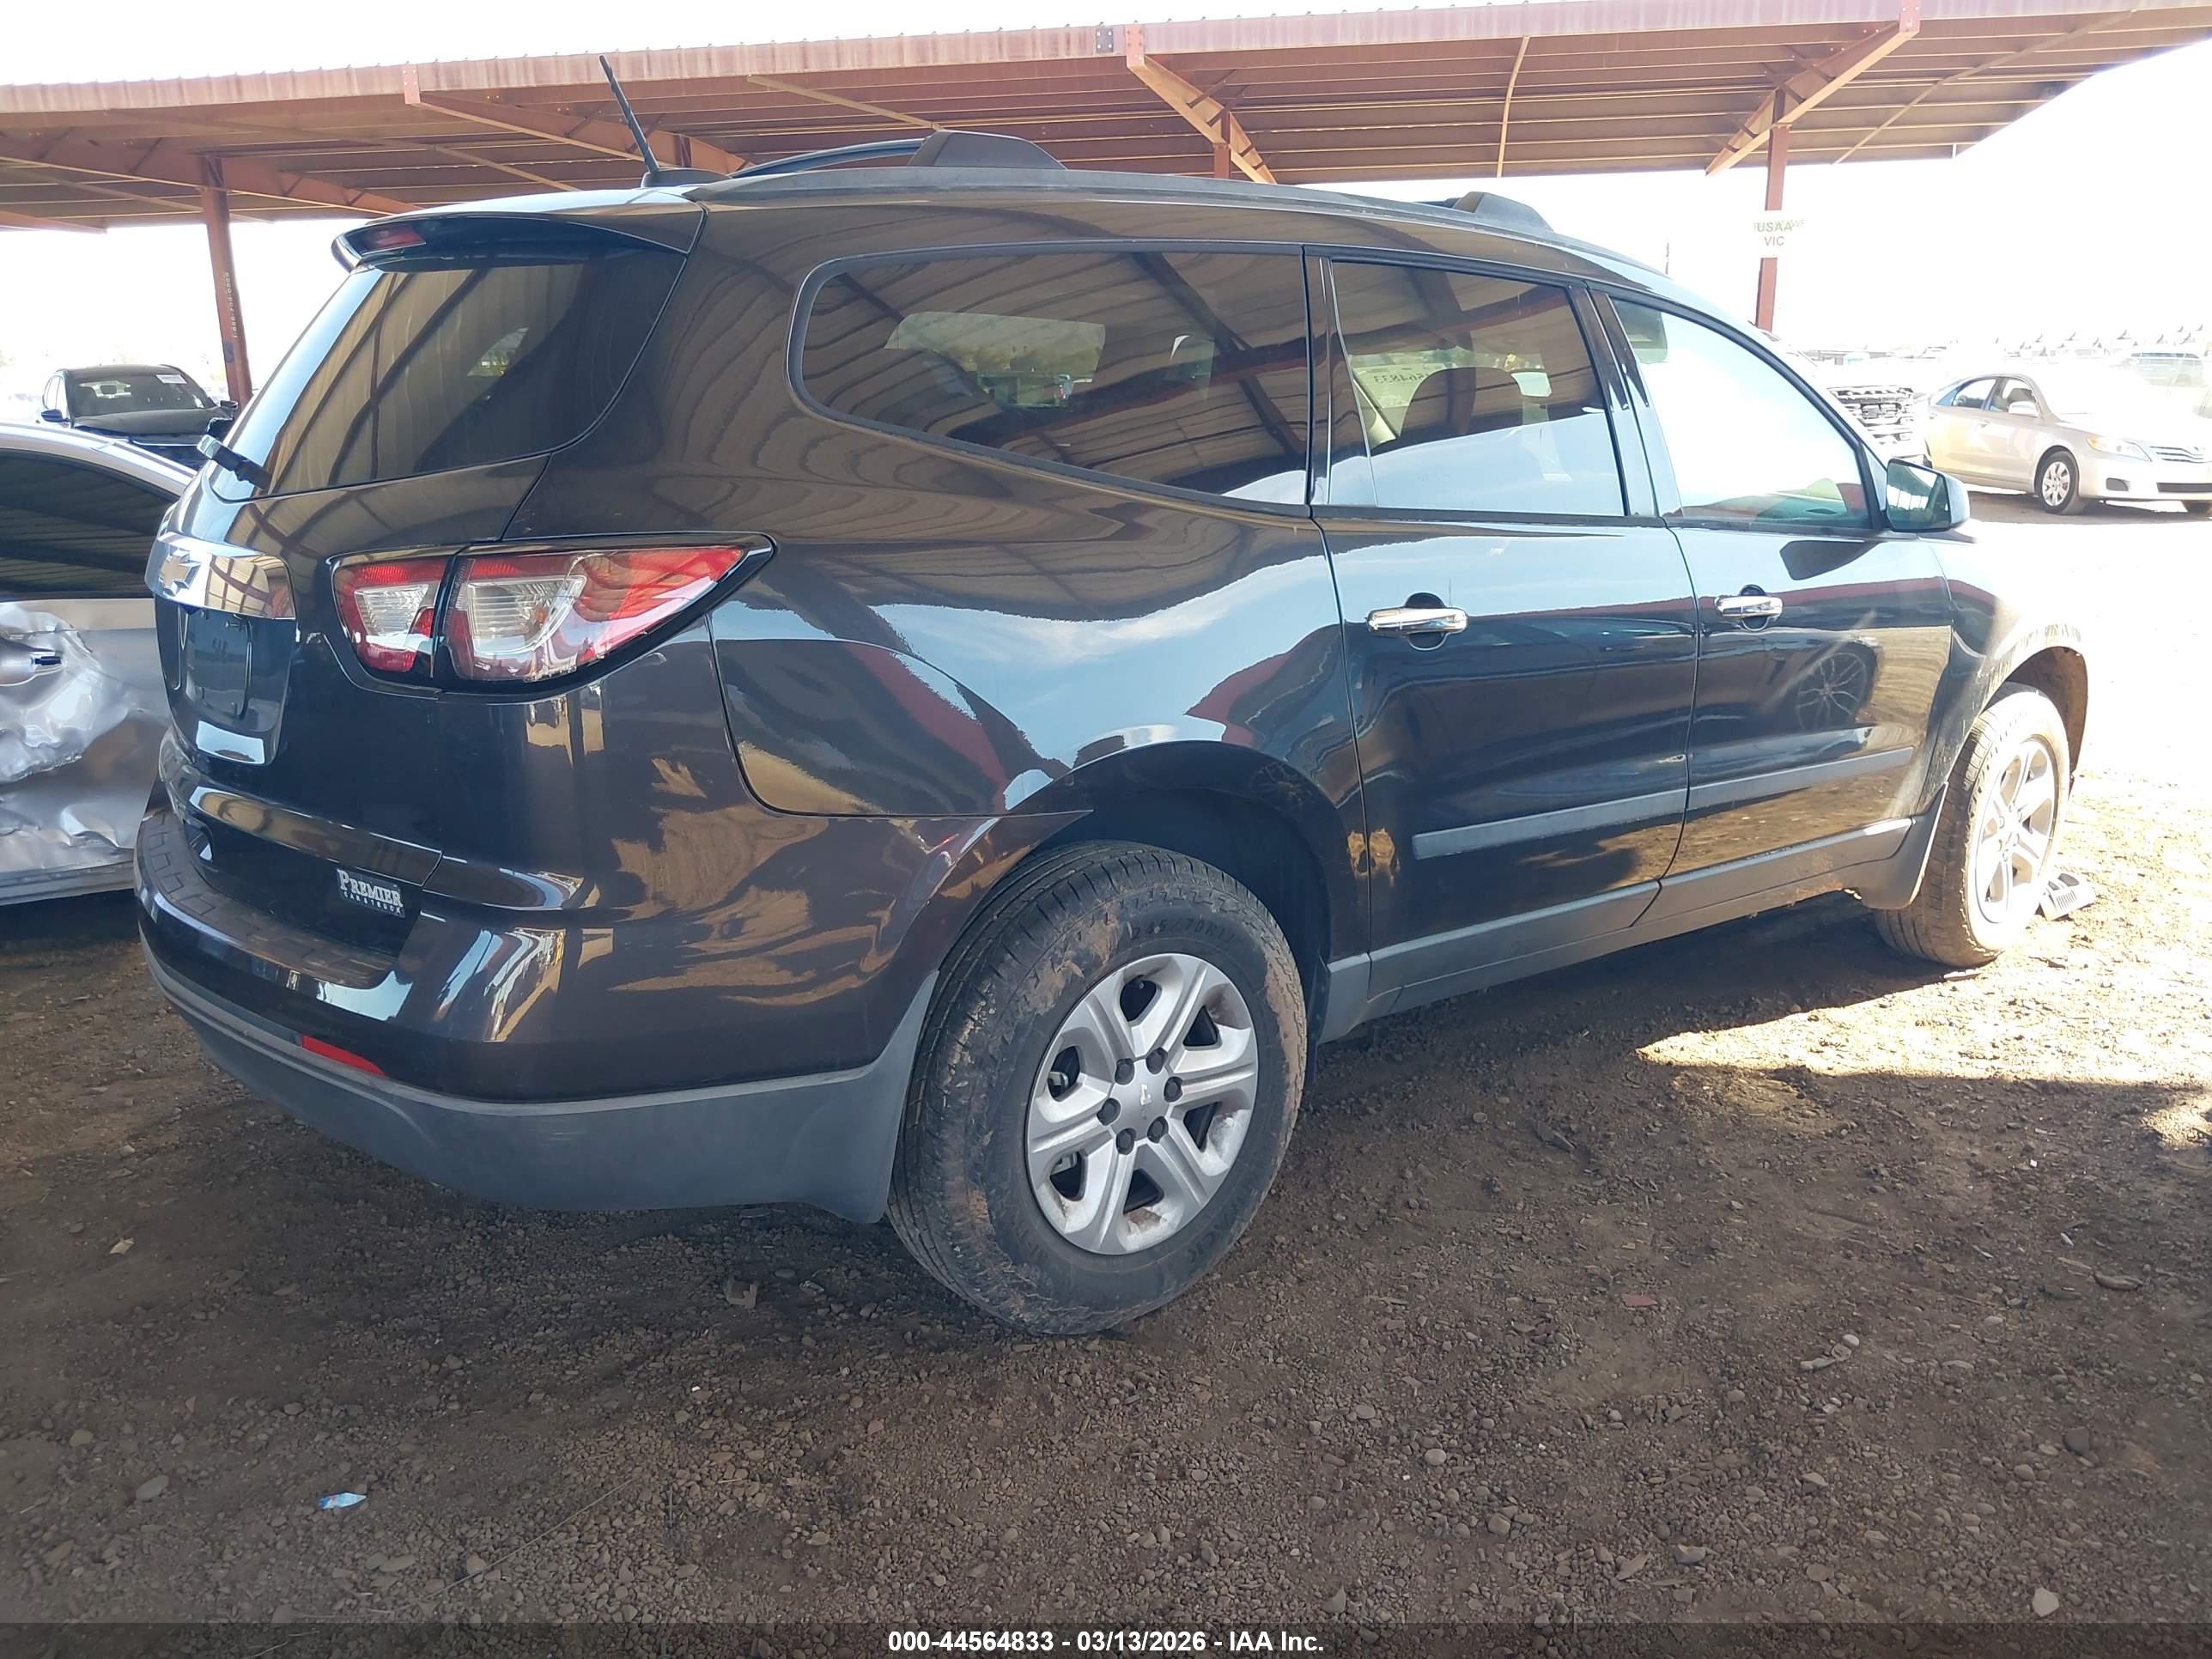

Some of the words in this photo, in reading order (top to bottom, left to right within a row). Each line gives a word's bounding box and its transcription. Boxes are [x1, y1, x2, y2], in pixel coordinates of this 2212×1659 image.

[1757, 221, 1794, 233] USAA
[1764, 234, 1785, 246] VIC
[337, 868, 403, 907] PREMIER
[371, 900, 401, 914] TRUCK
